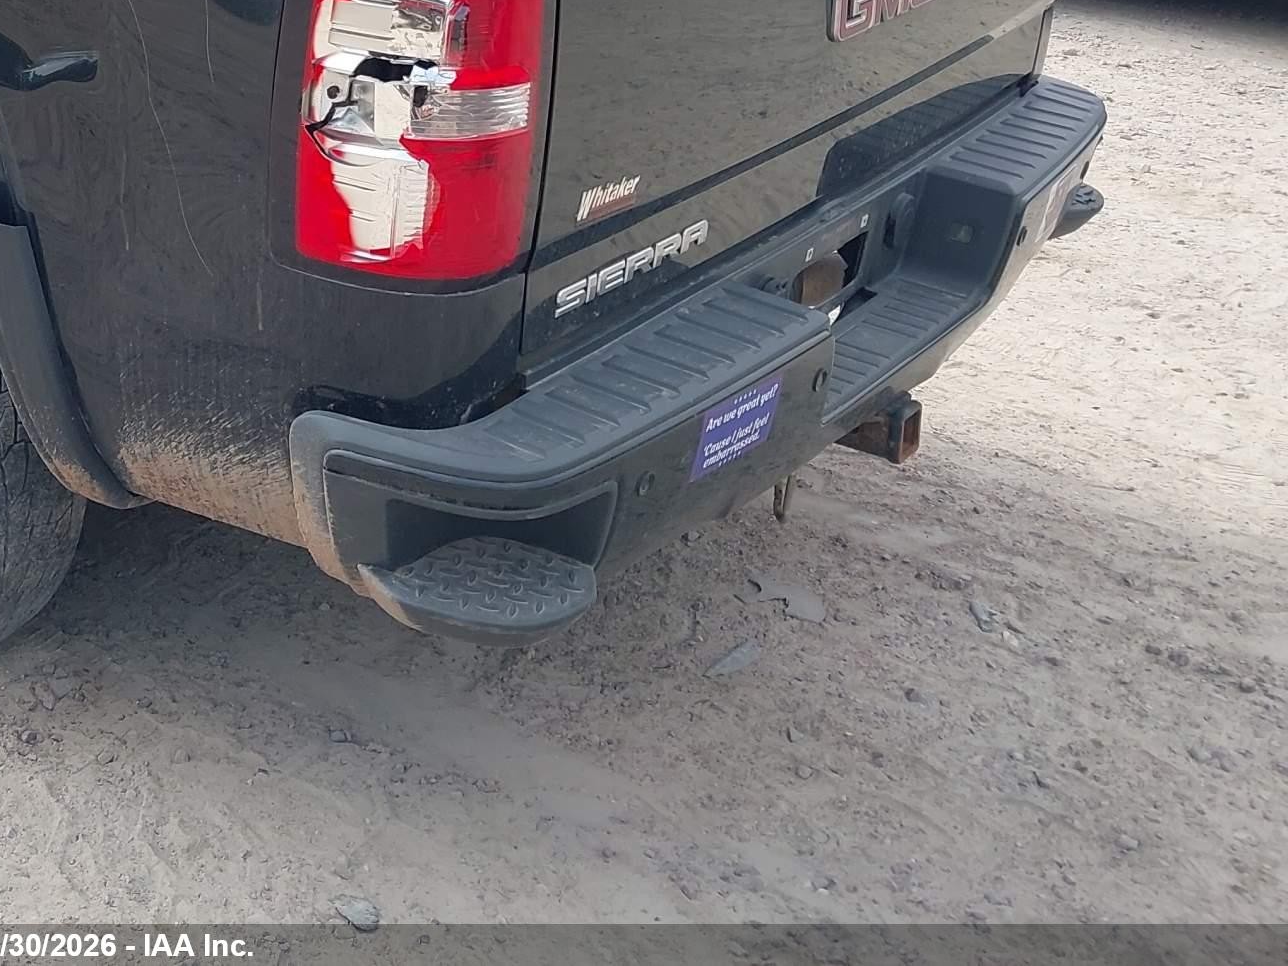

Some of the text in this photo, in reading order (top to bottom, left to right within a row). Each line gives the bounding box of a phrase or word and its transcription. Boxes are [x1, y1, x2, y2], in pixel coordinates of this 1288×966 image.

[576, 174, 641, 223] Whitaker
[554, 219, 709, 319] SIERRA
[705, 383, 779, 433] Are we great yet?
[734, 420, 754, 444] just
[752, 411, 770, 434] feel
